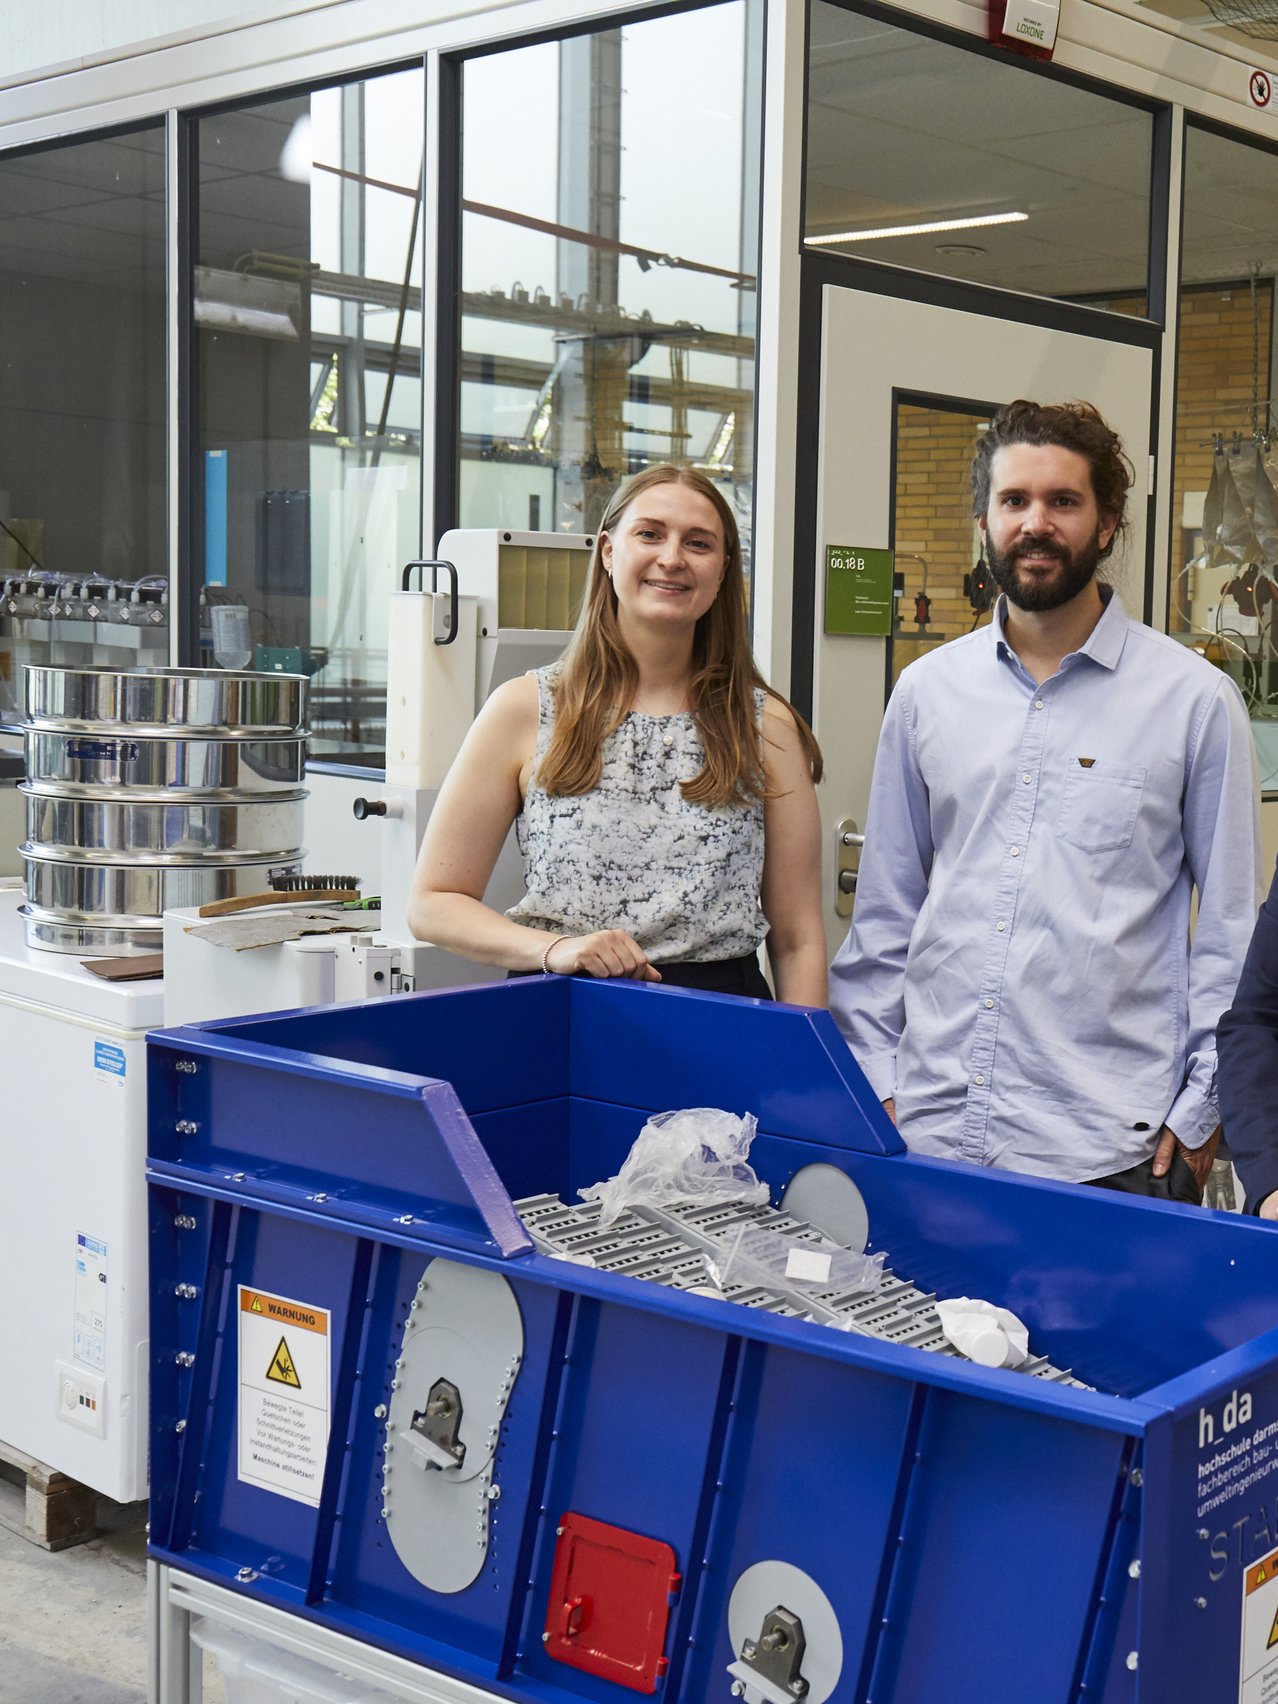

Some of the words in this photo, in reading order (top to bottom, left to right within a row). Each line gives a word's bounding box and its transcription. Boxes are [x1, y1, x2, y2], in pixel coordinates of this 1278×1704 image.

[1016, 22, 1045, 40] LOXONE
[830, 557, 856, 570] 00.18
[857, 558, 866, 571] B
[267, 1303, 316, 1326] WARNUNG
[1199, 1389, 1253, 1449] h_da
[252, 1453, 280, 1469] Maschine
[281, 1463, 315, 1481] stillsetzen!
[1197, 1454, 1251, 1499] fachbereich
[1252, 1445, 1273, 1464] bau-
[1198, 1436, 1252, 1480] hochschule
